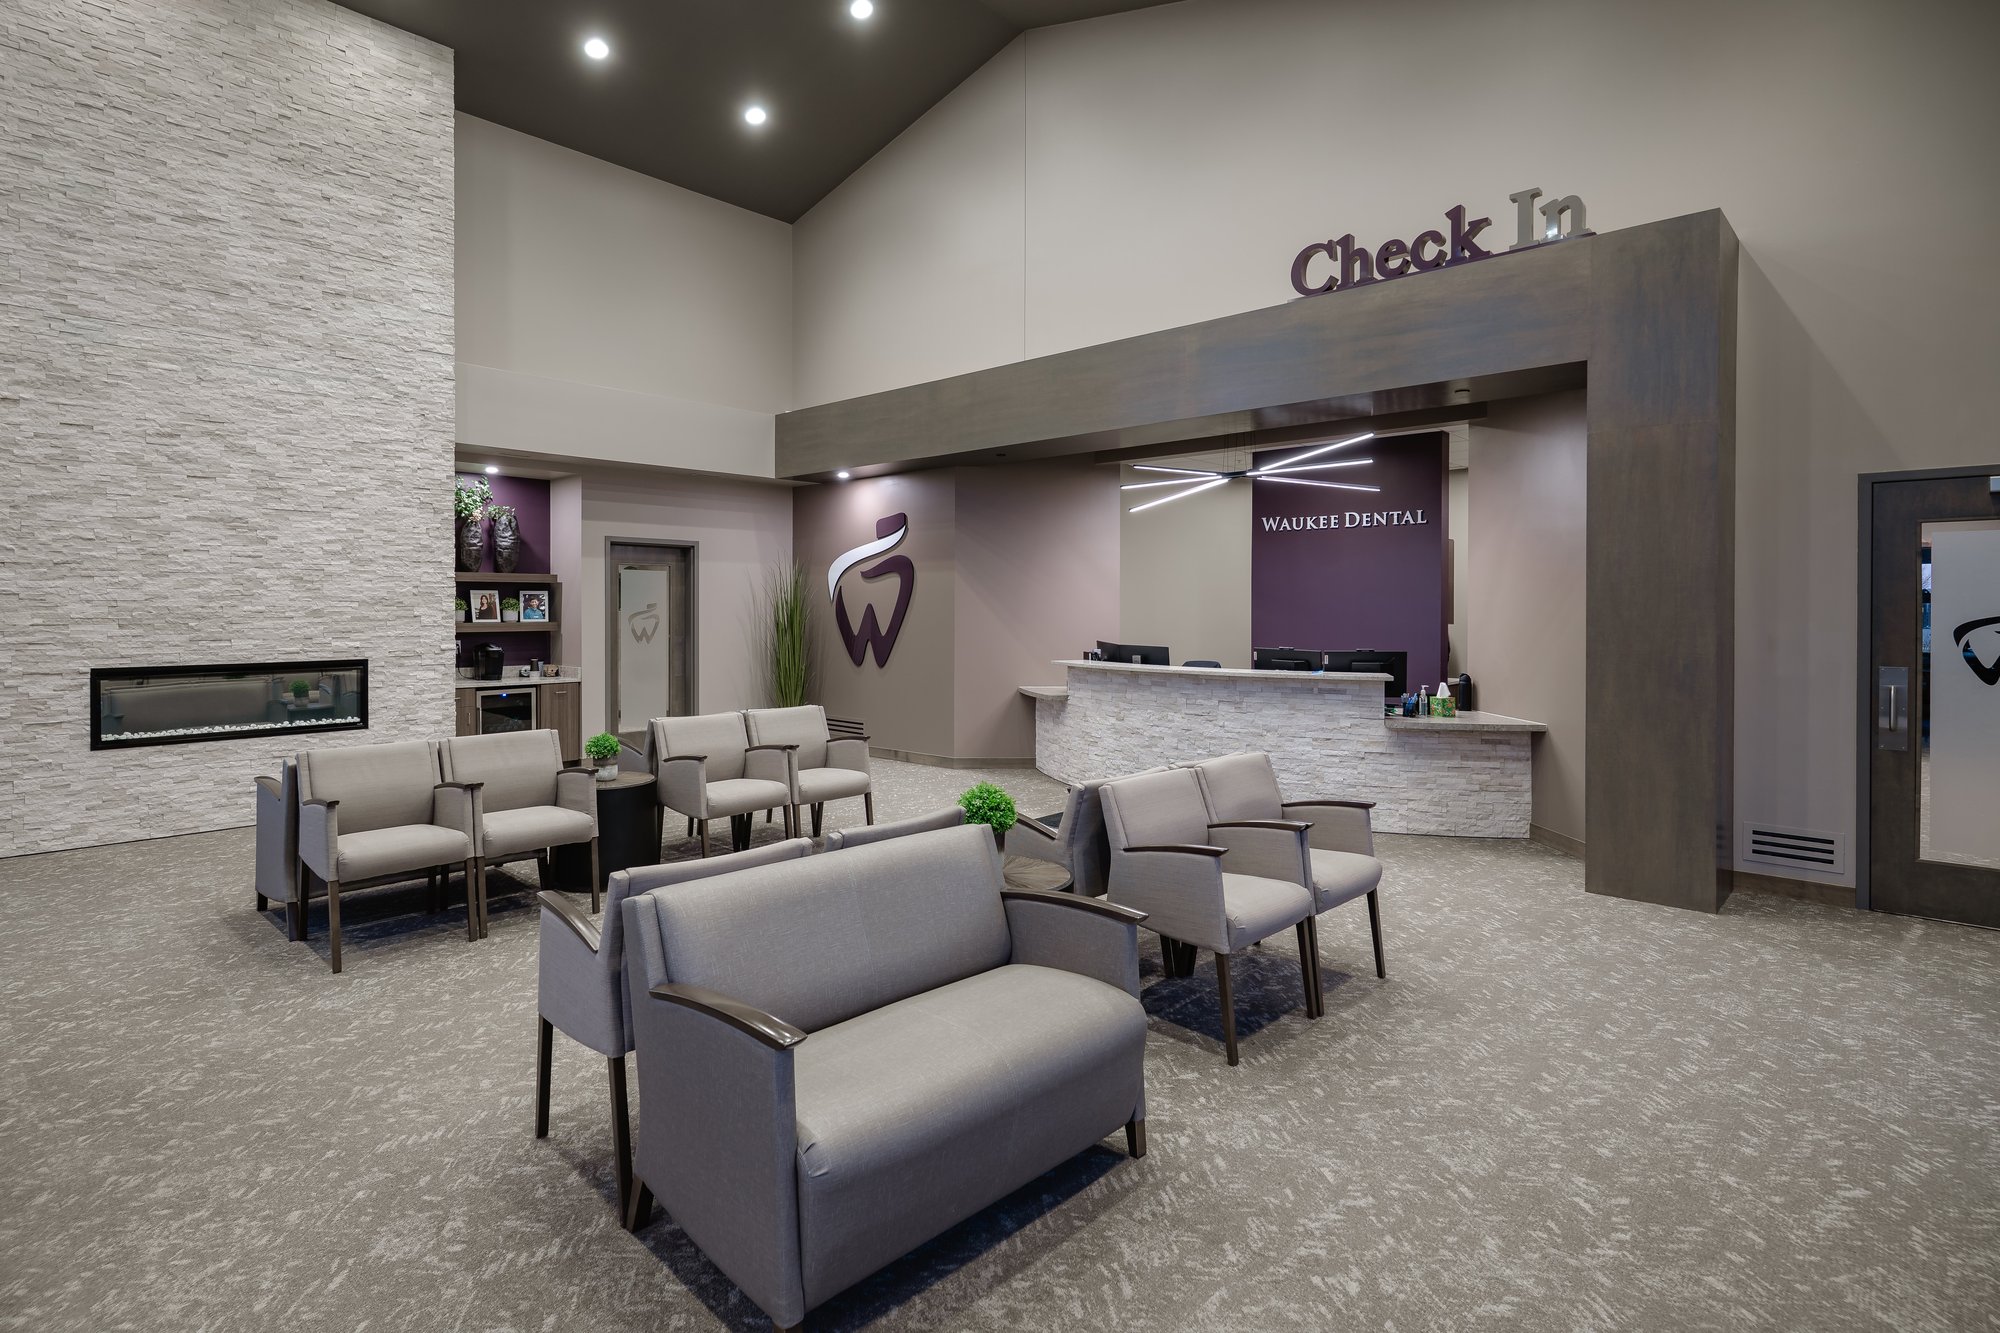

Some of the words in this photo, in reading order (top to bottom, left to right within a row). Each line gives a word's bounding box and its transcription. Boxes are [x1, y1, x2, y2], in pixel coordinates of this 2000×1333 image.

[1290, 204, 1493, 296] Check
[1508, 187, 1592, 250] In
[1261, 516, 1340, 532] WAUKEE
[1344, 509, 1427, 528] DENTAL
